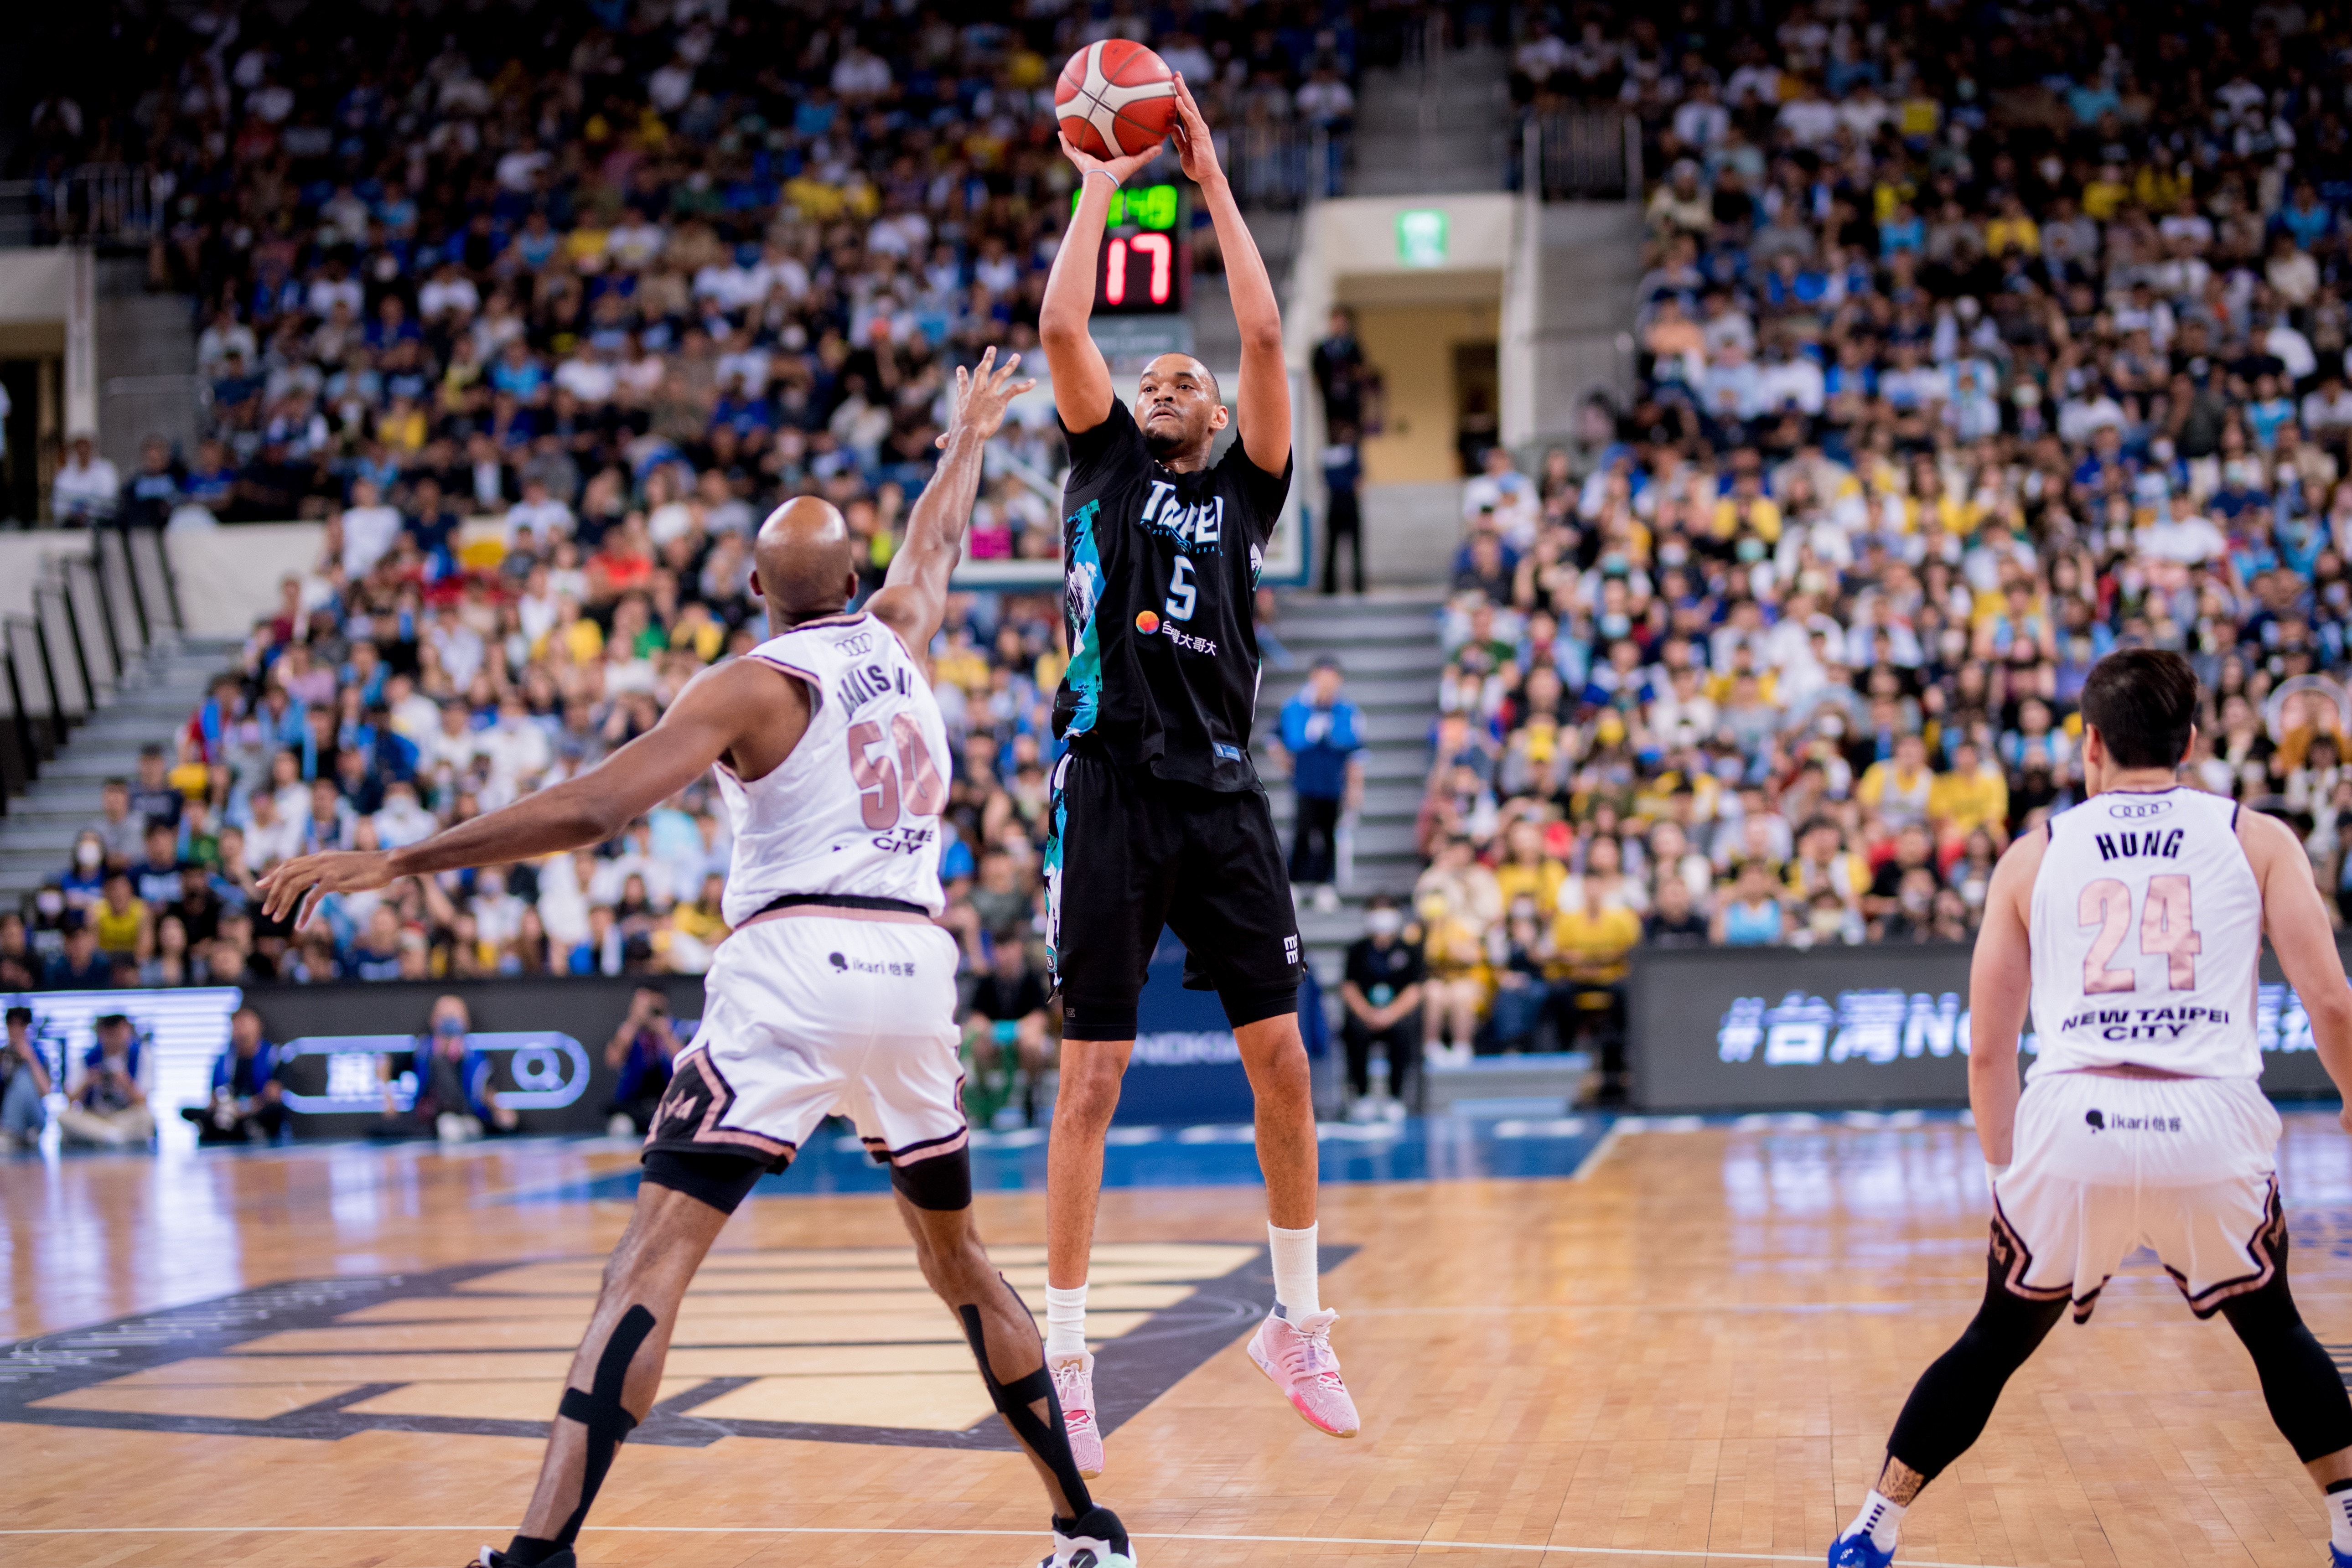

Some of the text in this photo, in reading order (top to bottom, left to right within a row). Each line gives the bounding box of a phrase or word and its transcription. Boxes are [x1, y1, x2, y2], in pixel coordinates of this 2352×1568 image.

[1106, 233, 1171, 305] 17
[1196, 545, 1223, 557] BRAS
[1165, 555, 1197, 621] 5
[1162, 620, 1217, 656] 台灣大哥大
[847, 711, 946, 831] 50
[872, 837, 922, 854] CIY
[2095, 828, 2185, 861] HUNG
[2077, 874, 2202, 996] 24
[2061, 1007, 2229, 1032] NEW TAIPEI
[2103, 1023, 2188, 1041] CITY
